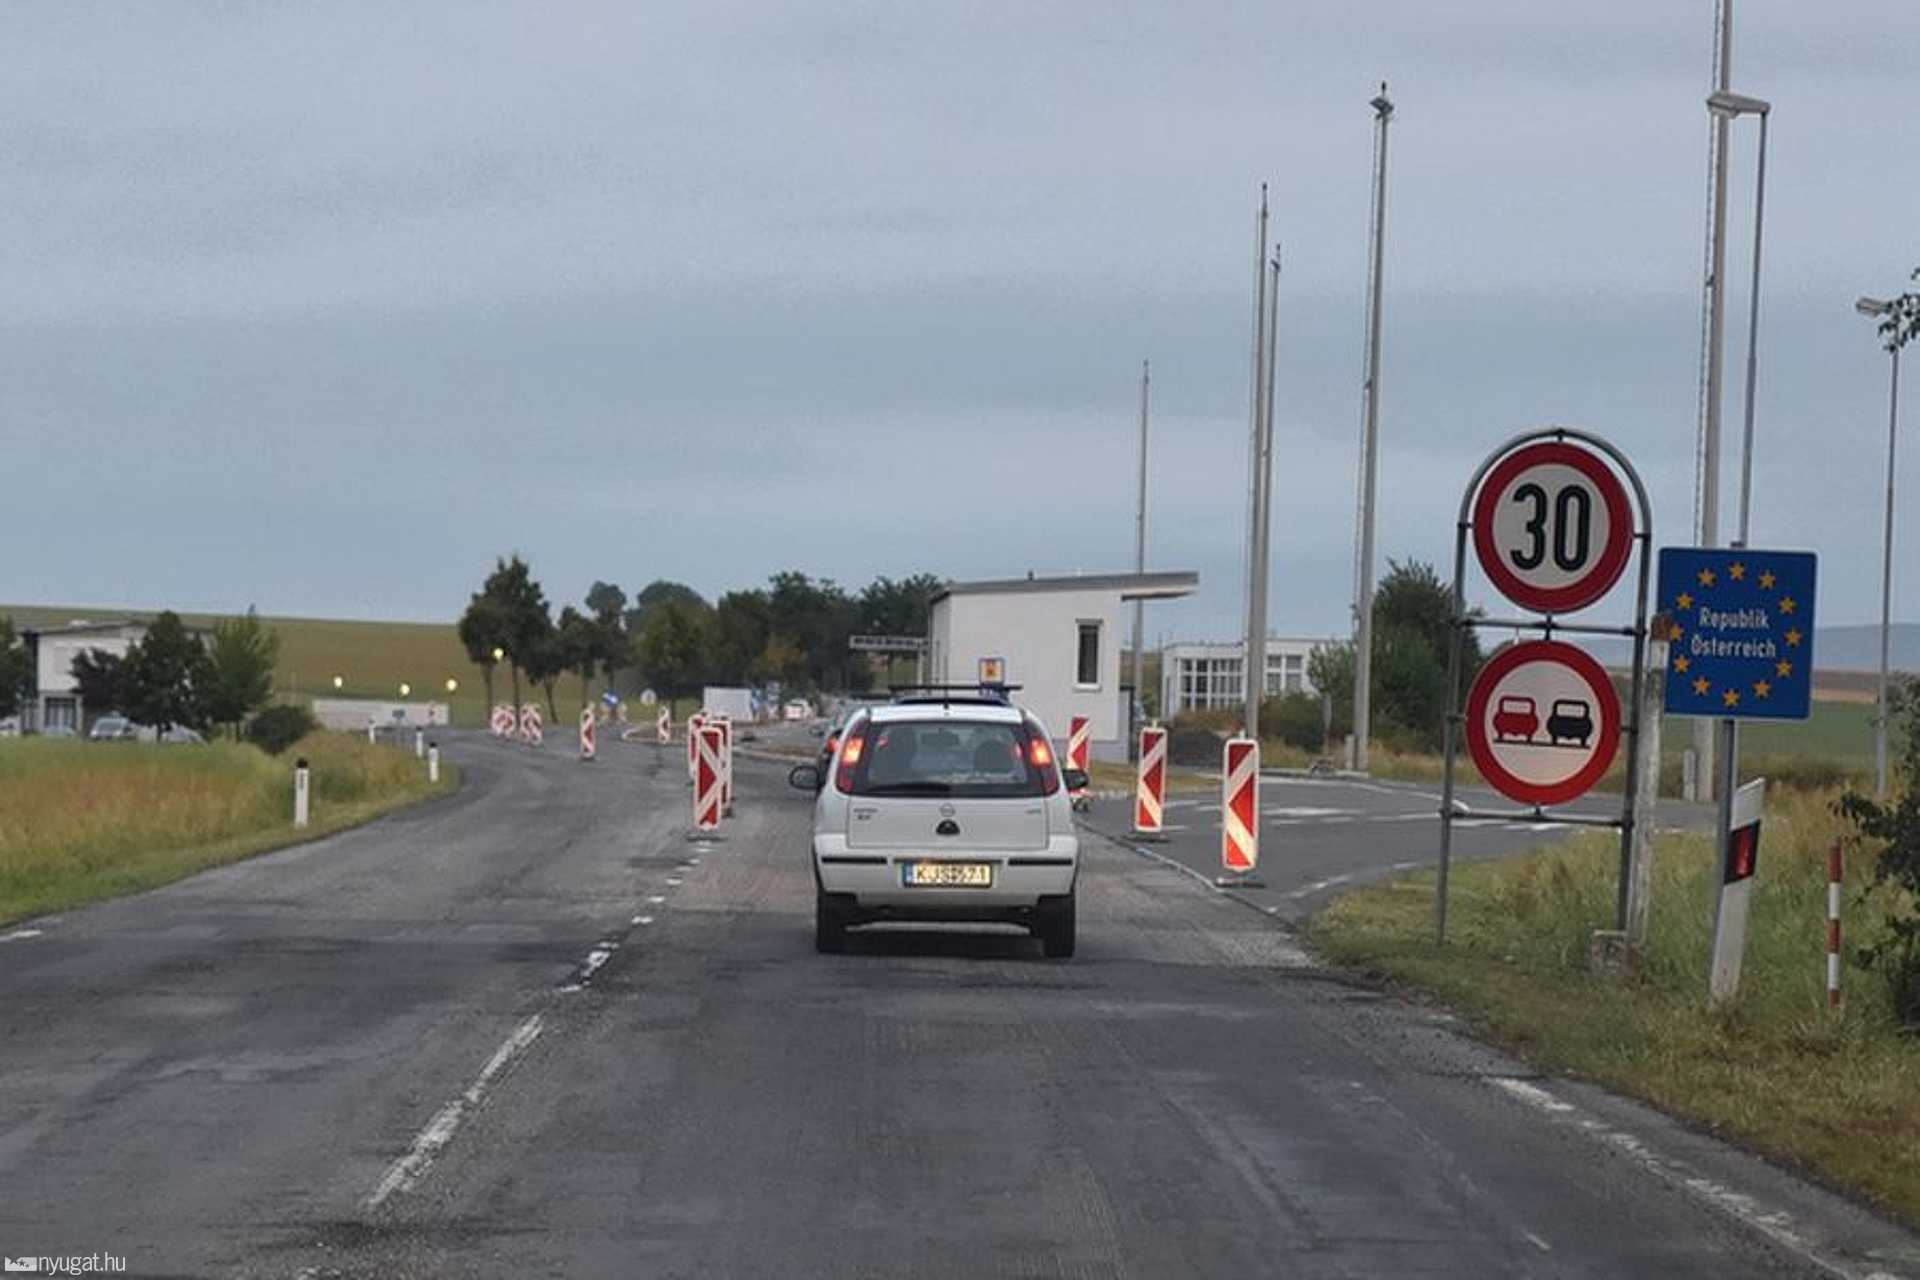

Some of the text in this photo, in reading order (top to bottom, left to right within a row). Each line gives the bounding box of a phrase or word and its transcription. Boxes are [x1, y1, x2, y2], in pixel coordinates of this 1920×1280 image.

[1510, 483, 1591, 572] 30
[1698, 606, 1770, 631] Republik
[1690, 633, 1776, 658] Österreich
